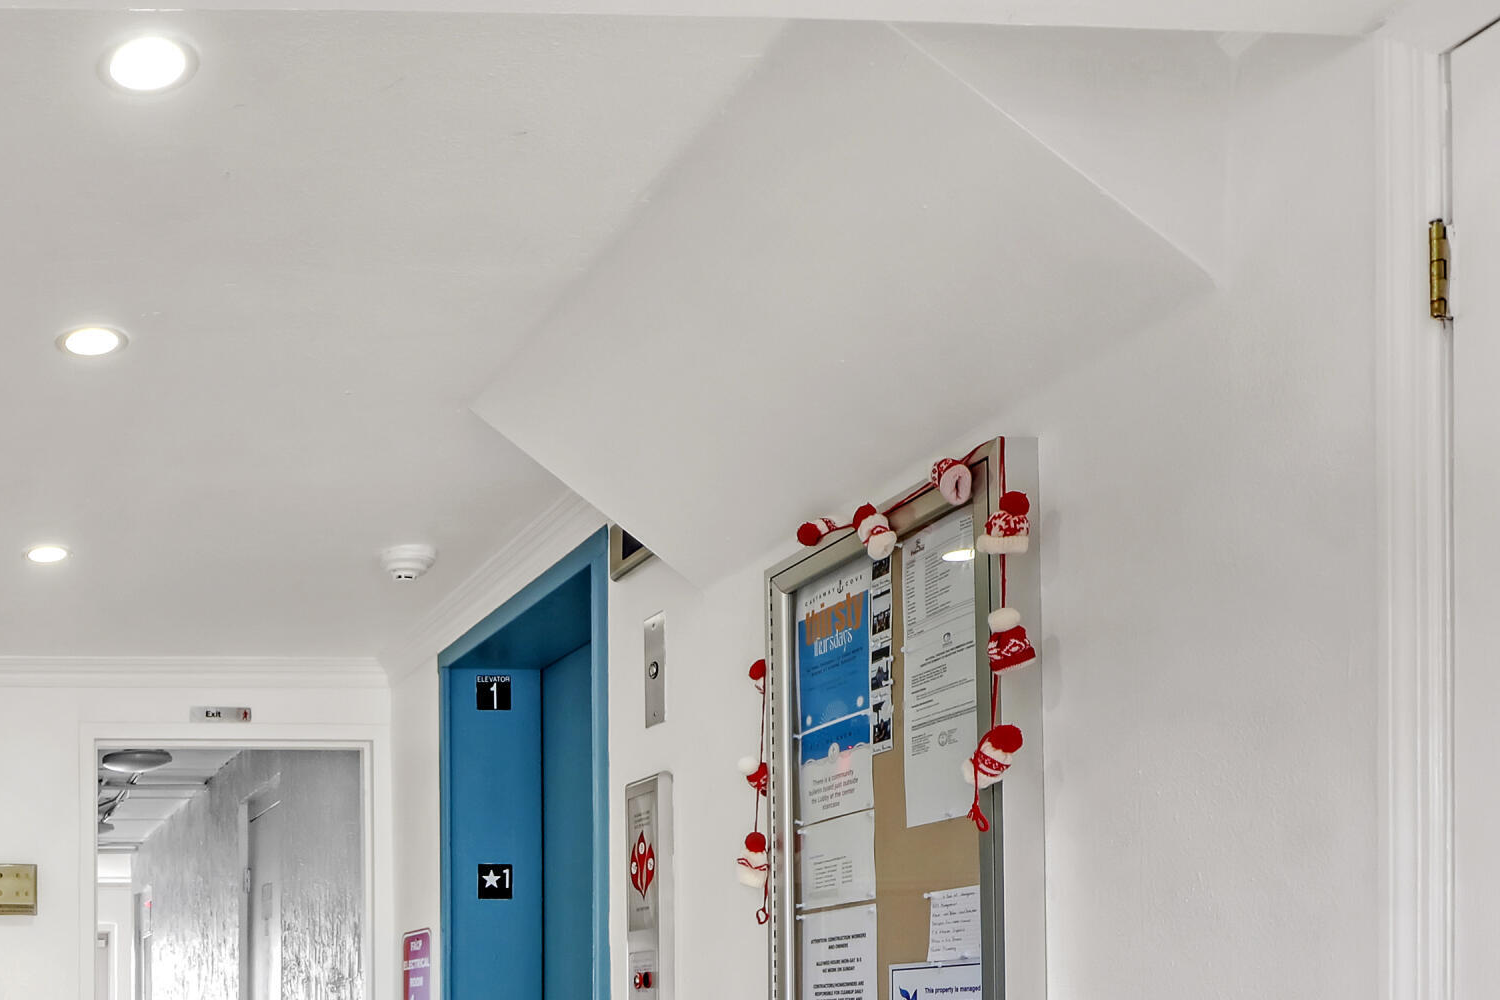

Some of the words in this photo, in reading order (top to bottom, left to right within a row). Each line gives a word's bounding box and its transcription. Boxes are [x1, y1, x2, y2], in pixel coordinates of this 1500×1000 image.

[805, 588, 835, 607] CASTAWAY
[845, 574, 863, 587] COVE
[805, 592, 864, 646] thirsty
[477, 675, 510, 683] ELEVATOR
[490, 682, 498, 710] 1
[205, 710, 221, 718] Exit
[503, 868, 510, 889] 1
[828, 934, 850, 942] CONSTRUCTION
[935, 986, 953, 995] property
[959, 985, 981, 993] managed
